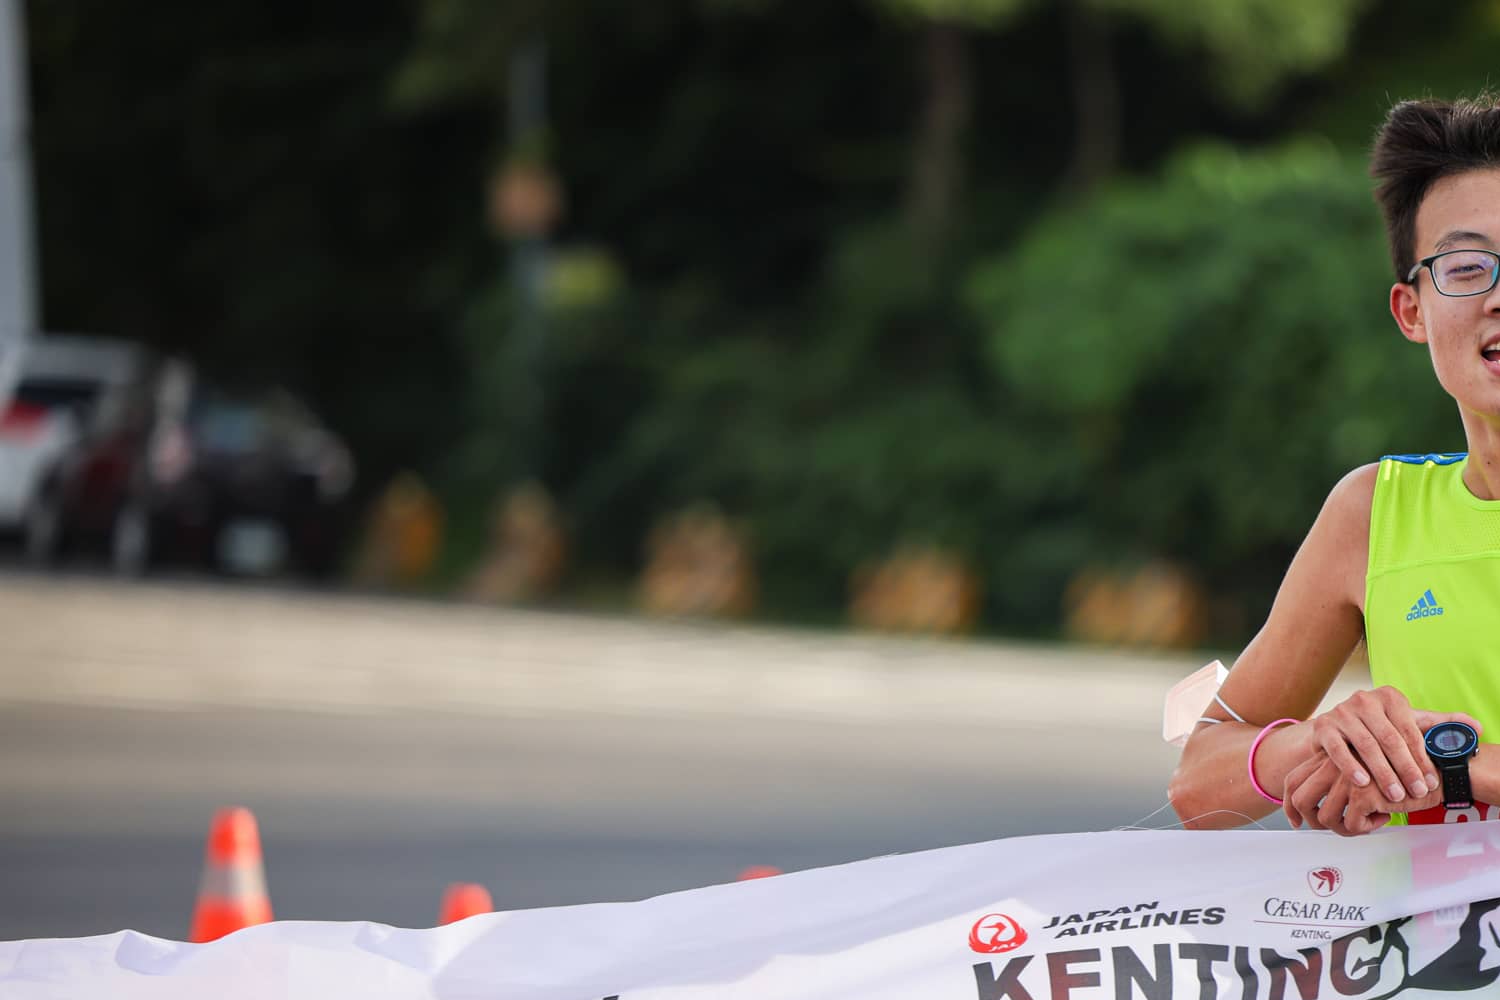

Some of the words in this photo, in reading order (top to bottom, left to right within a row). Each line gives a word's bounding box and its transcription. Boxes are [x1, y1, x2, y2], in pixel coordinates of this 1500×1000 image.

[1407, 606, 1443, 621] adidas
[1043, 901, 1159, 929] JAPAN
[1324, 903, 1370, 921] PARK
[1054, 907, 1226, 939] AIRLINES
[1290, 929, 1332, 940] KENTING
